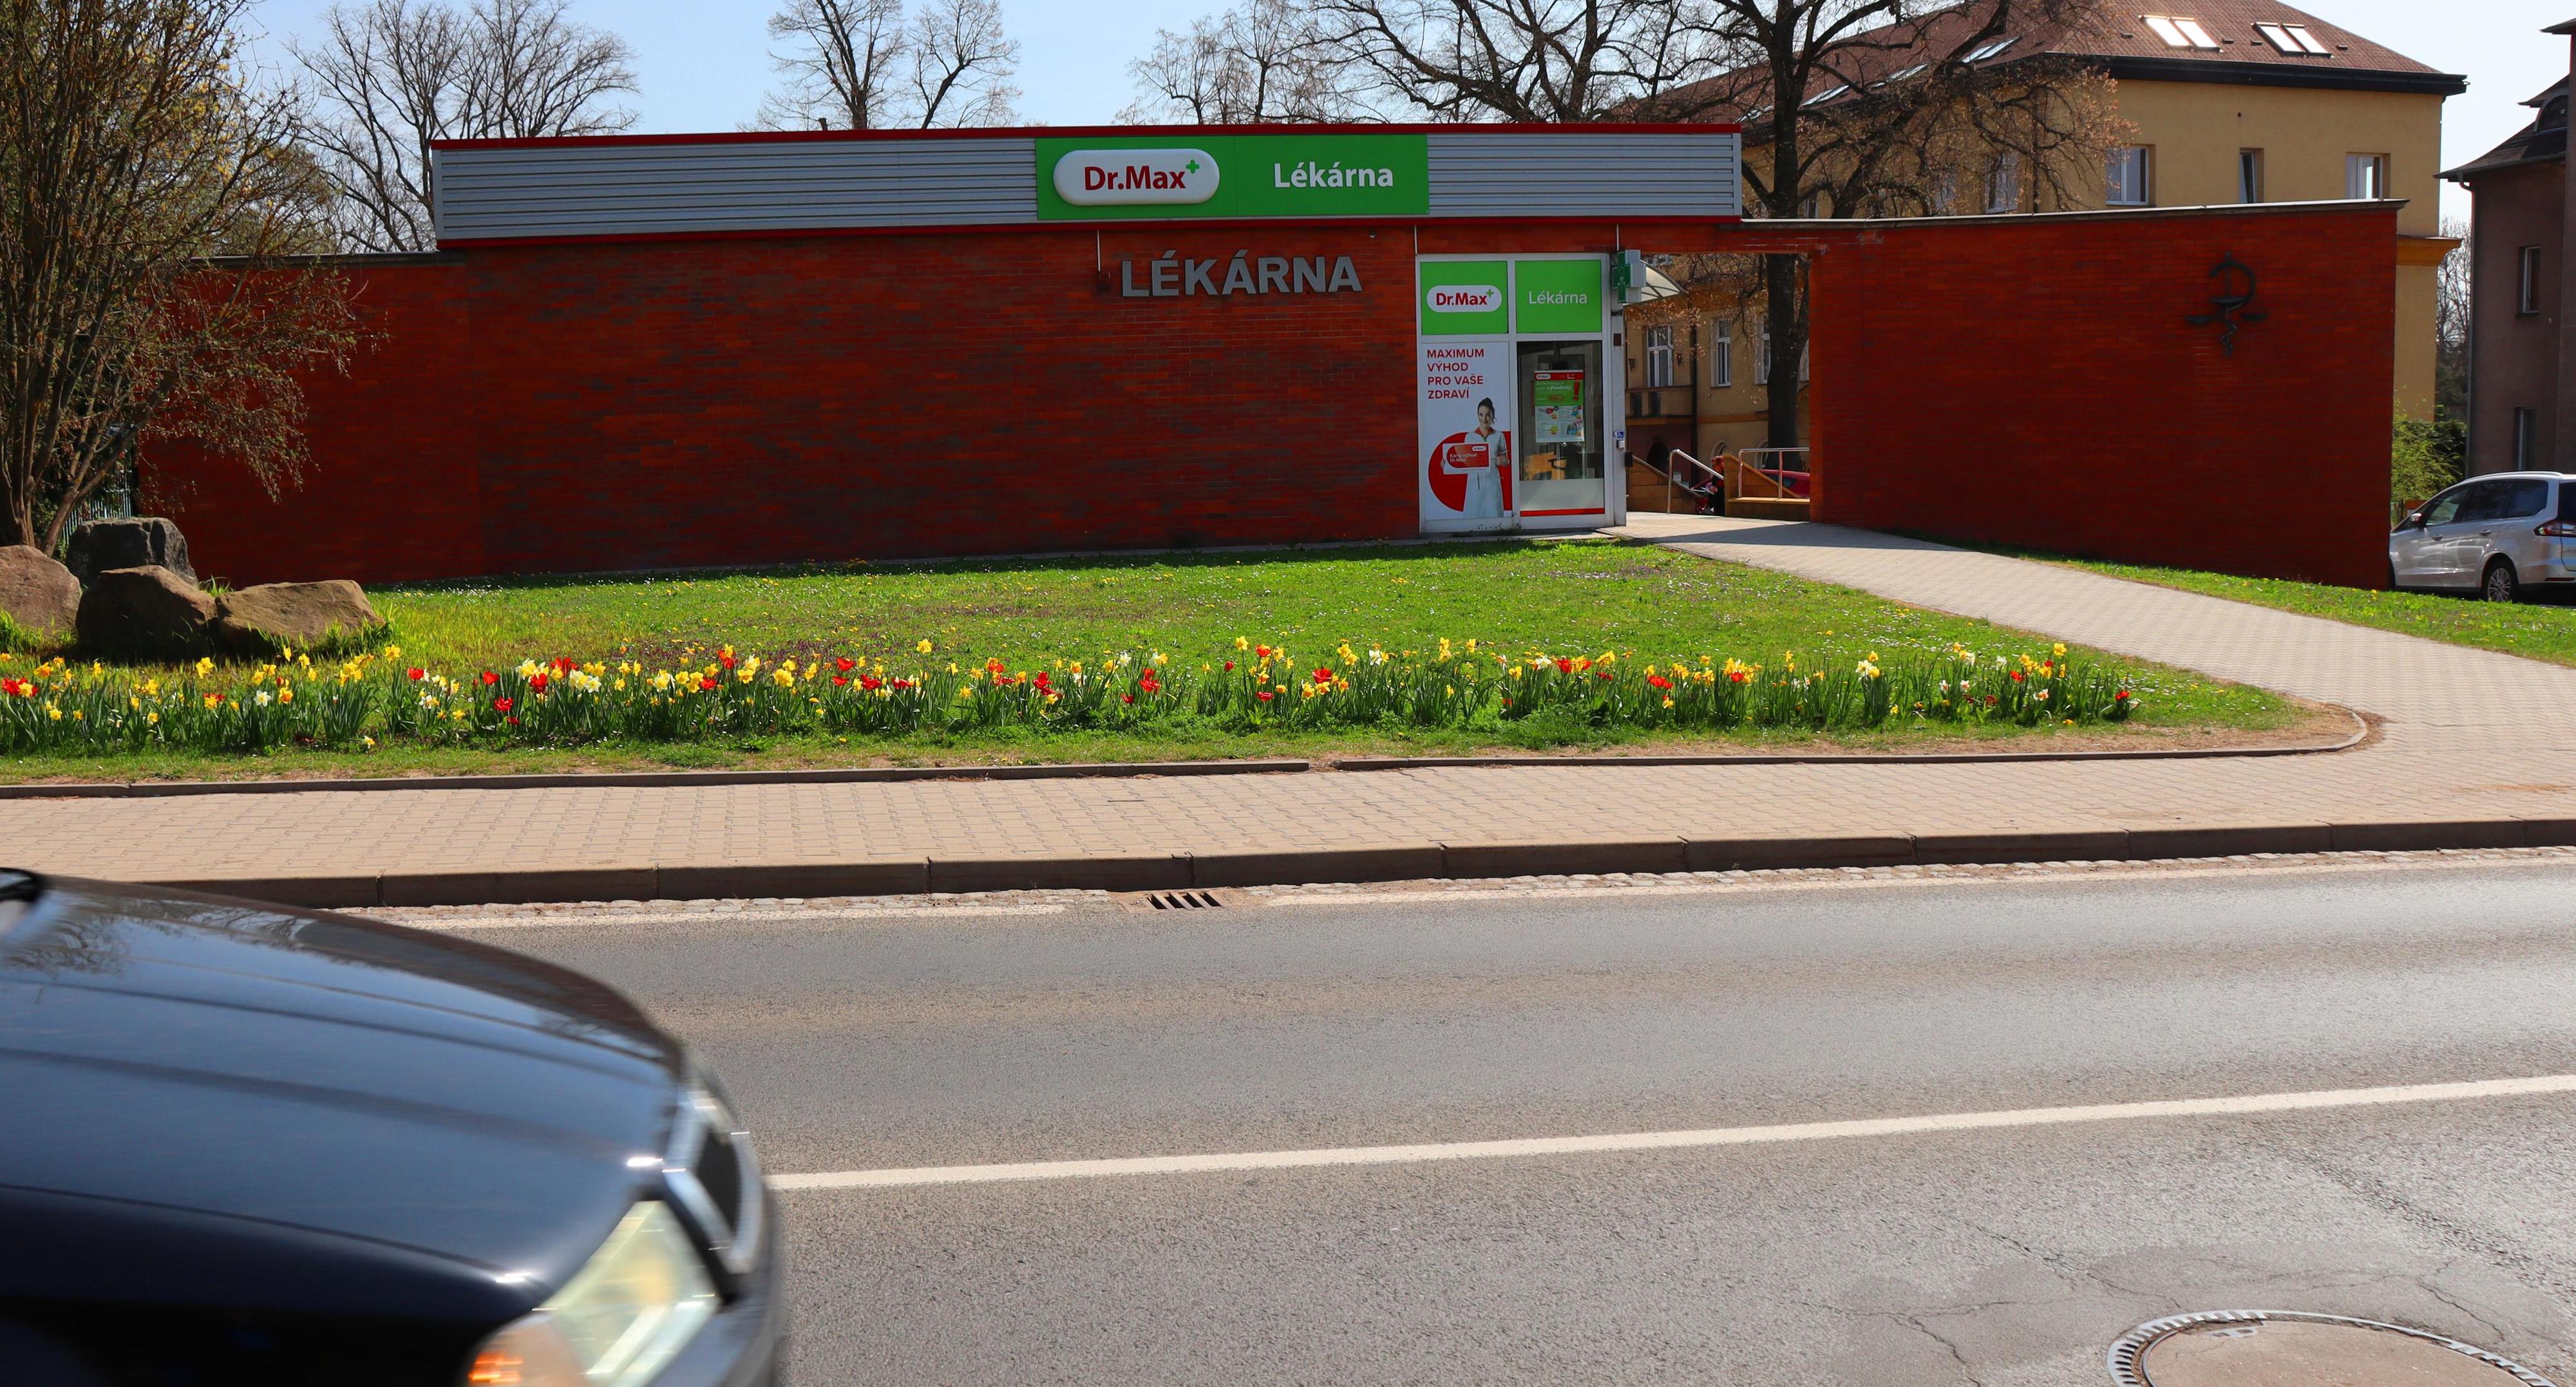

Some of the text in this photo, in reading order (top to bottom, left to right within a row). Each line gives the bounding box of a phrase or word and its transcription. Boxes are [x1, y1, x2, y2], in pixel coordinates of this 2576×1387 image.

[1084, 165, 1186, 191] Dr.Max
[1274, 162, 1394, 188] Lékárna
[1121, 250, 1363, 297] LÉKÁRNA
[1436, 292, 1487, 306] Dr.Max
[1528, 290, 1587, 304] Lékárna
[1427, 349, 1484, 358] MAXIMUM
[1427, 360, 1468, 372] VÝHOD
[1428, 374, 1484, 385] PRO VAŠE
[1428, 387, 1470, 399] ZDRAVÍ
